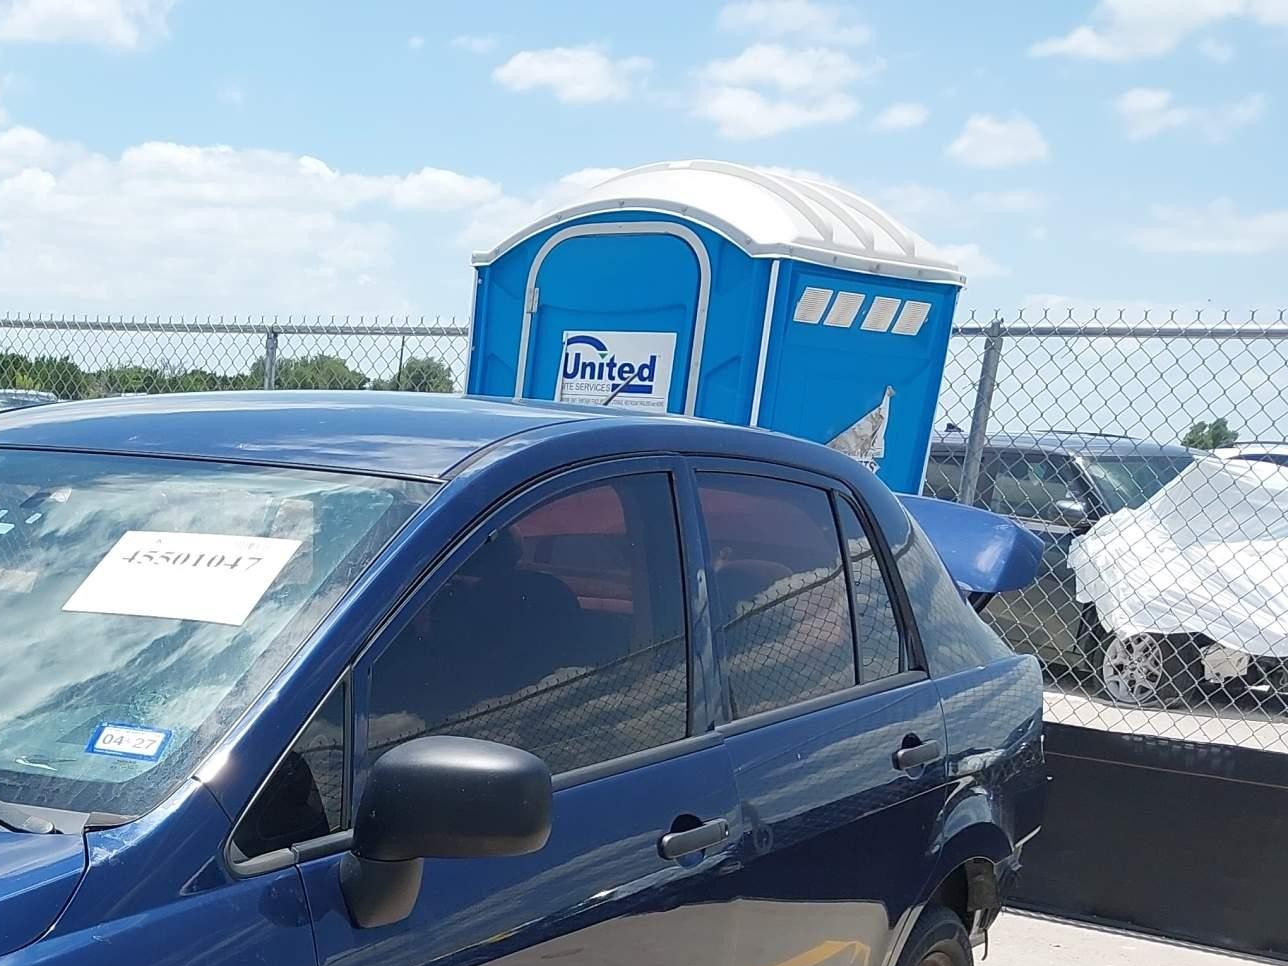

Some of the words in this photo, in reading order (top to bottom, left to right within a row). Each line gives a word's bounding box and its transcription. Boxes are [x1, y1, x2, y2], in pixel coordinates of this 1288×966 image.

[562, 352, 657, 383] United
[562, 382, 575, 392] ITE
[575, 382, 611, 393] SERVICES
[122, 550, 264, 570] 45501047
[102, 733, 125, 746] 04
[132, 737, 157, 750] 27
